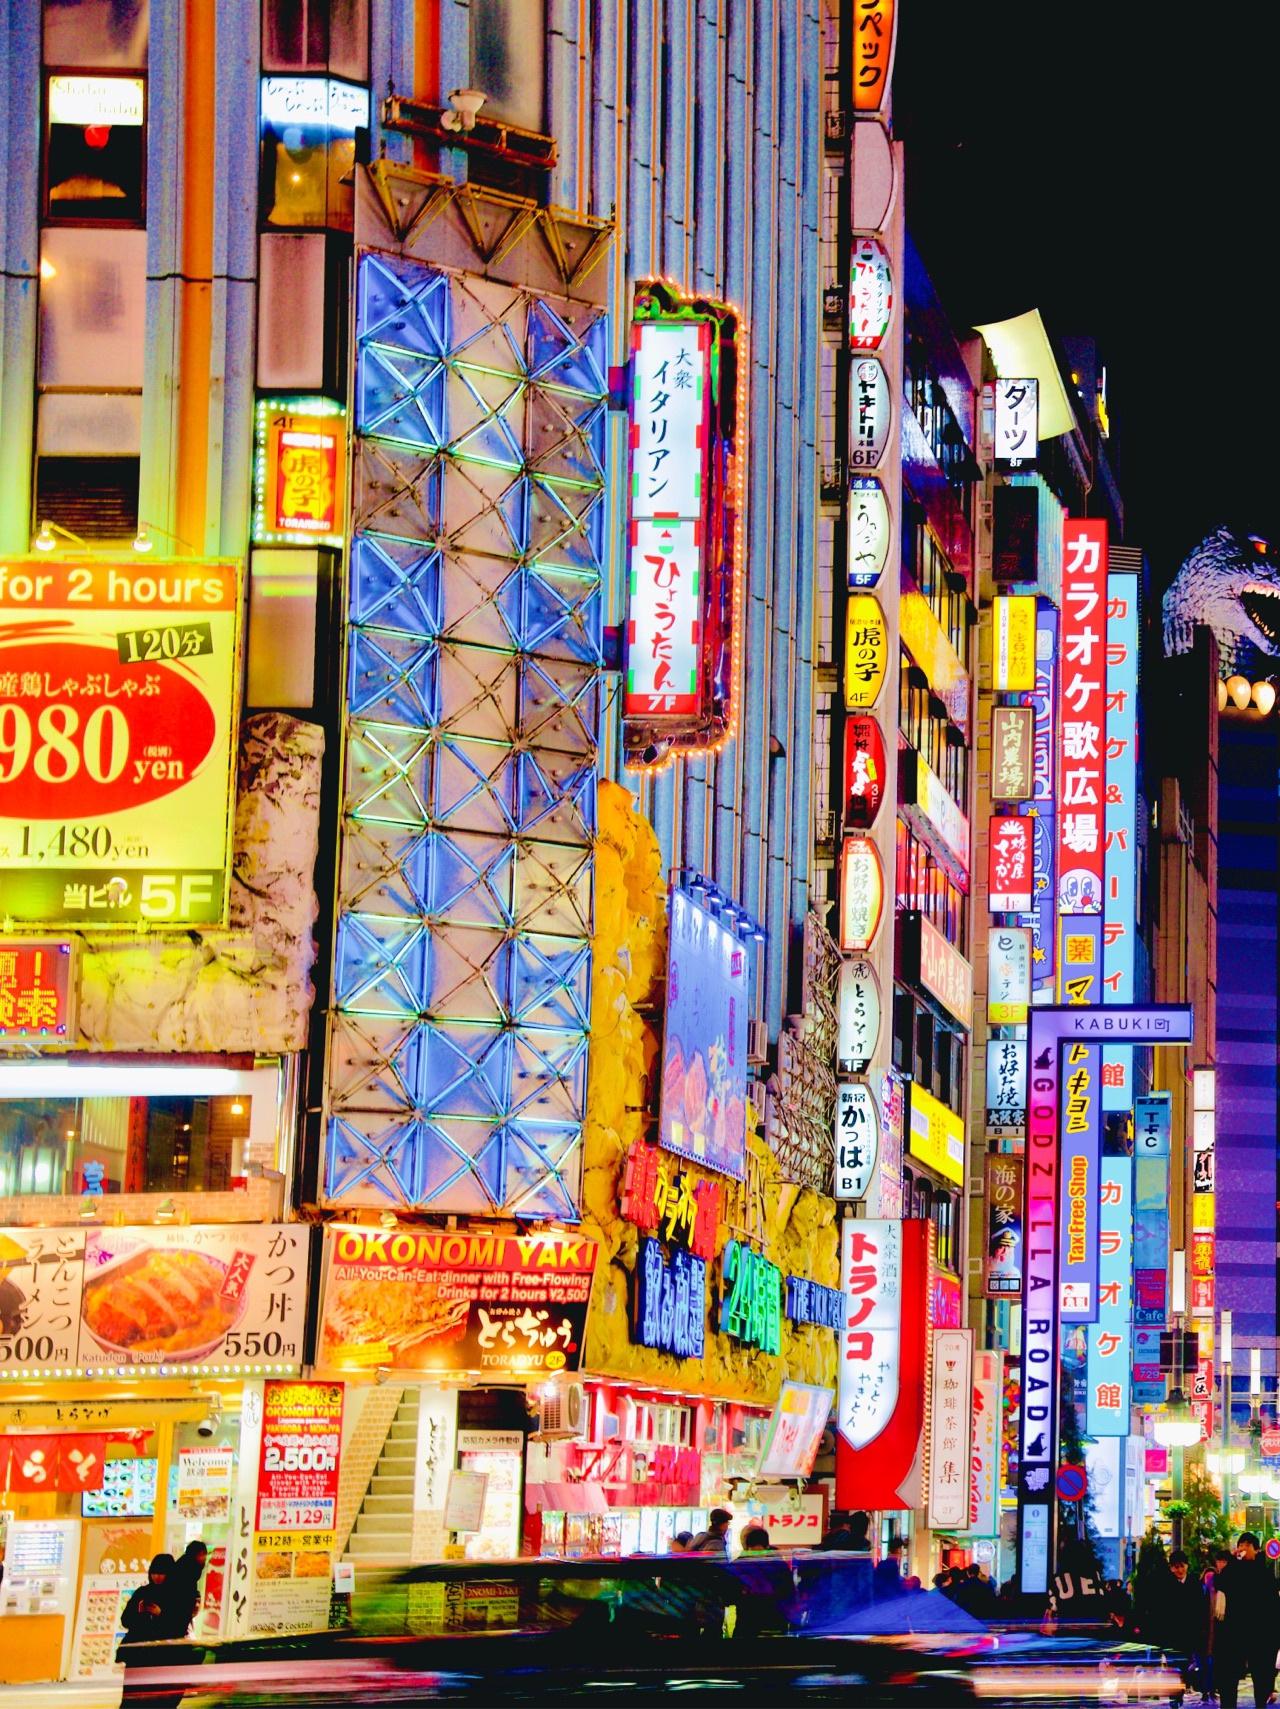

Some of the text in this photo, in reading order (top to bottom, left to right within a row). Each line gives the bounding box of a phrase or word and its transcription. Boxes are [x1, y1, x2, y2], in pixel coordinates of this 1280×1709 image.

[672, 347, 694, 390] 大衆
[858, 380, 876, 438] ヤキトリ
[1003, 384, 1029, 451] ダーツ
[647, 360, 671, 499] イタリアン
[851, 449, 880, 466] 6F
[0, 567, 225, 602] for 2 hours
[855, 574, 873, 585] 5F
[643, 553, 681, 691] ひょうたん
[123, 626, 206, 663] 120分
[852, 627, 881, 682] 虎の子
[646, 695, 676, 711] 7F
[1062, 533, 1102, 856] カラオケ歌広場
[997, 712, 1026, 786] 山内農場
[133, 756, 185, 785] yen
[111, 843, 150, 864] yen
[139, 873, 214, 918] 5F
[1068, 936, 1093, 962] 薬
[998, 1004, 1020, 1019] 3F
[844, 1059, 863, 1072] 1F
[996, 1043, 1021, 1108] お好み焼
[988, 1110, 1026, 1127] 大阪家
[842, 1177, 861, 1190] B1
[994, 1164, 1017, 1224] 海の家
[1067, 1156, 1088, 1265] Tax Free Shop
[337, 1231, 594, 1270] OKONOMI YAKI
[1027, 1076, 1056, 1423] GODZILLA ROAD
[264, 1231, 297, 1324] かつ丼
[437, 1286, 478, 1300] Drinks
[479, 1287, 498, 1300] for
[500, 1287, 509, 1300] 2
[511, 1287, 547, 1301] hours
[439, 1270, 481, 1285] dinner
[482, 1271, 509, 1286] with
[511, 1272, 590, 1289] Free-Flowing
[846, 1231, 878, 1361] トラノコ
[1096, 1178, 1124, 1409] カラオケ館
[1135, 1309, 1164, 1322] Cafe
[224, 1332, 296, 1358] 550円
[767, 1513, 819, 1529] トラノコ
